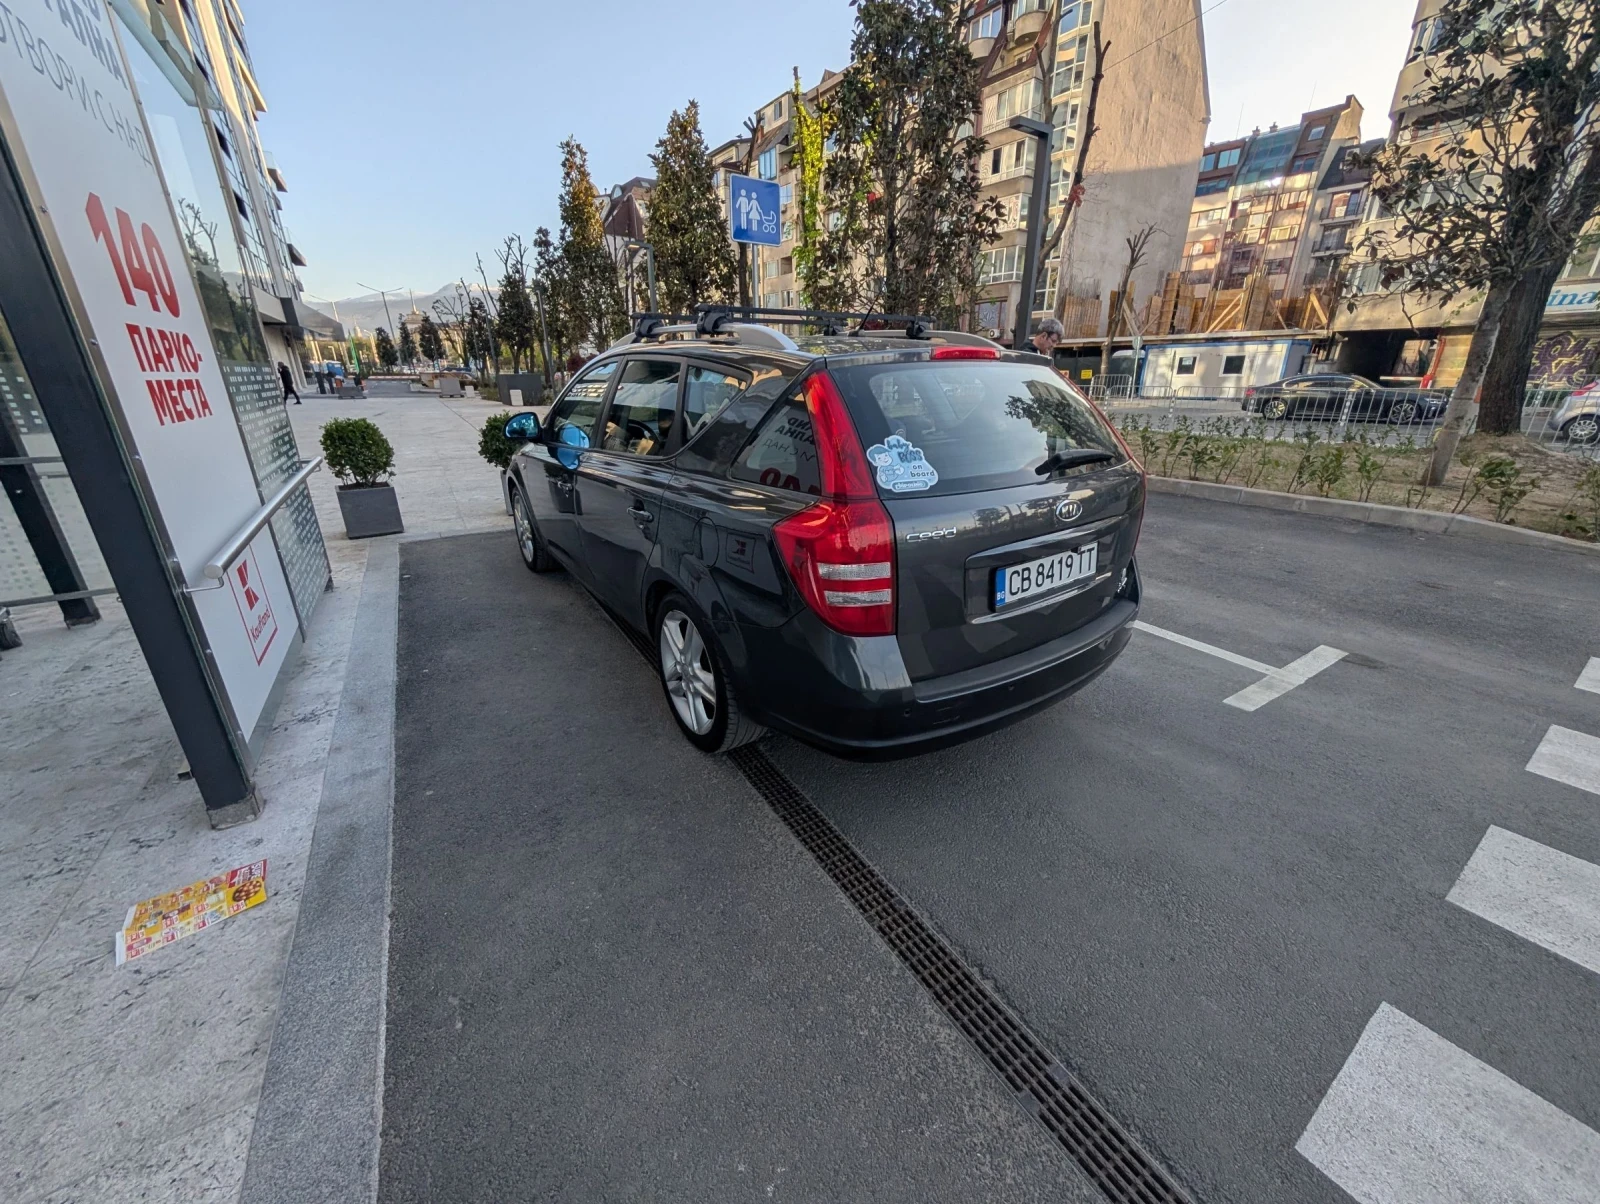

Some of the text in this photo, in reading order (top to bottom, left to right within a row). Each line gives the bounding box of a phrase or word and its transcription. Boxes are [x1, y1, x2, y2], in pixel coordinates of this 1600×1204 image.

[85, 191, 181, 319] 140
[125, 322, 203, 373] ПАРКО-
[145, 379, 213, 426] МЕСТА
[996, 590, 1005, 601] BG
[1009, 546, 1095, 596] CB 8419 TT
